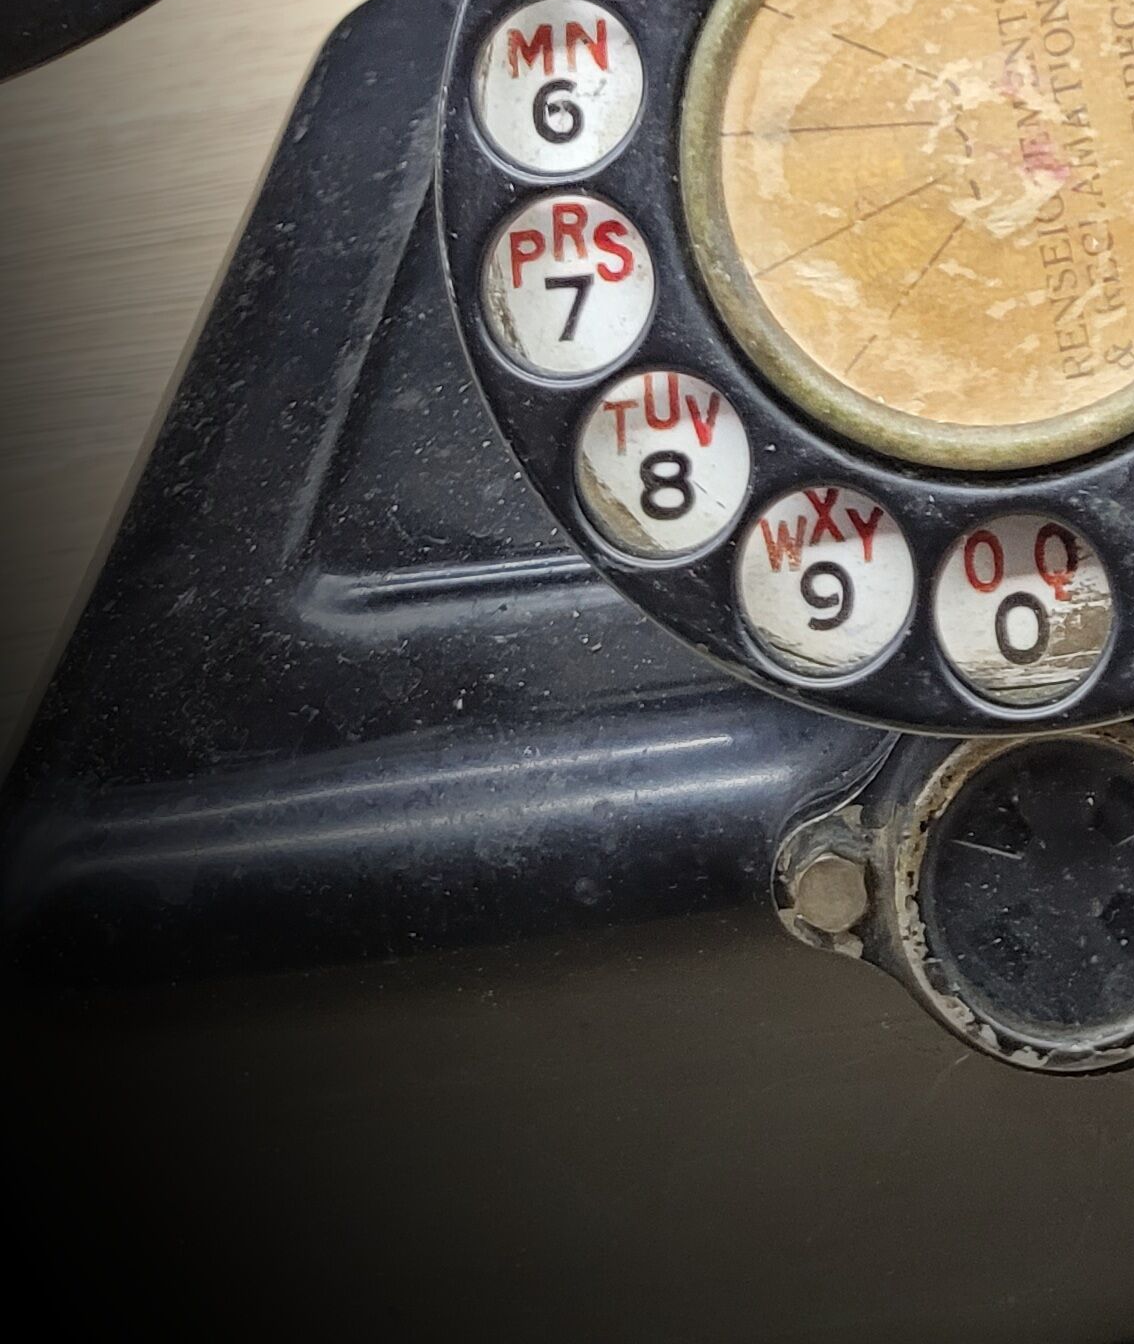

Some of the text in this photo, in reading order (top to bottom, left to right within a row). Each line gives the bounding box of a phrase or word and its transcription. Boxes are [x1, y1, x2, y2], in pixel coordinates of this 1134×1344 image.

[507, 19, 611, 79] MN
[532, 79, 585, 144] 6
[509, 203, 634, 289] PRS
[544, 273, 595, 342] 7
[603, 372, 720, 456] TUV
[640, 450, 696, 521] 8
[759, 488, 884, 573] WXY
[800, 561, 856, 632] 9
[994, 590, 1050, 665] 0
